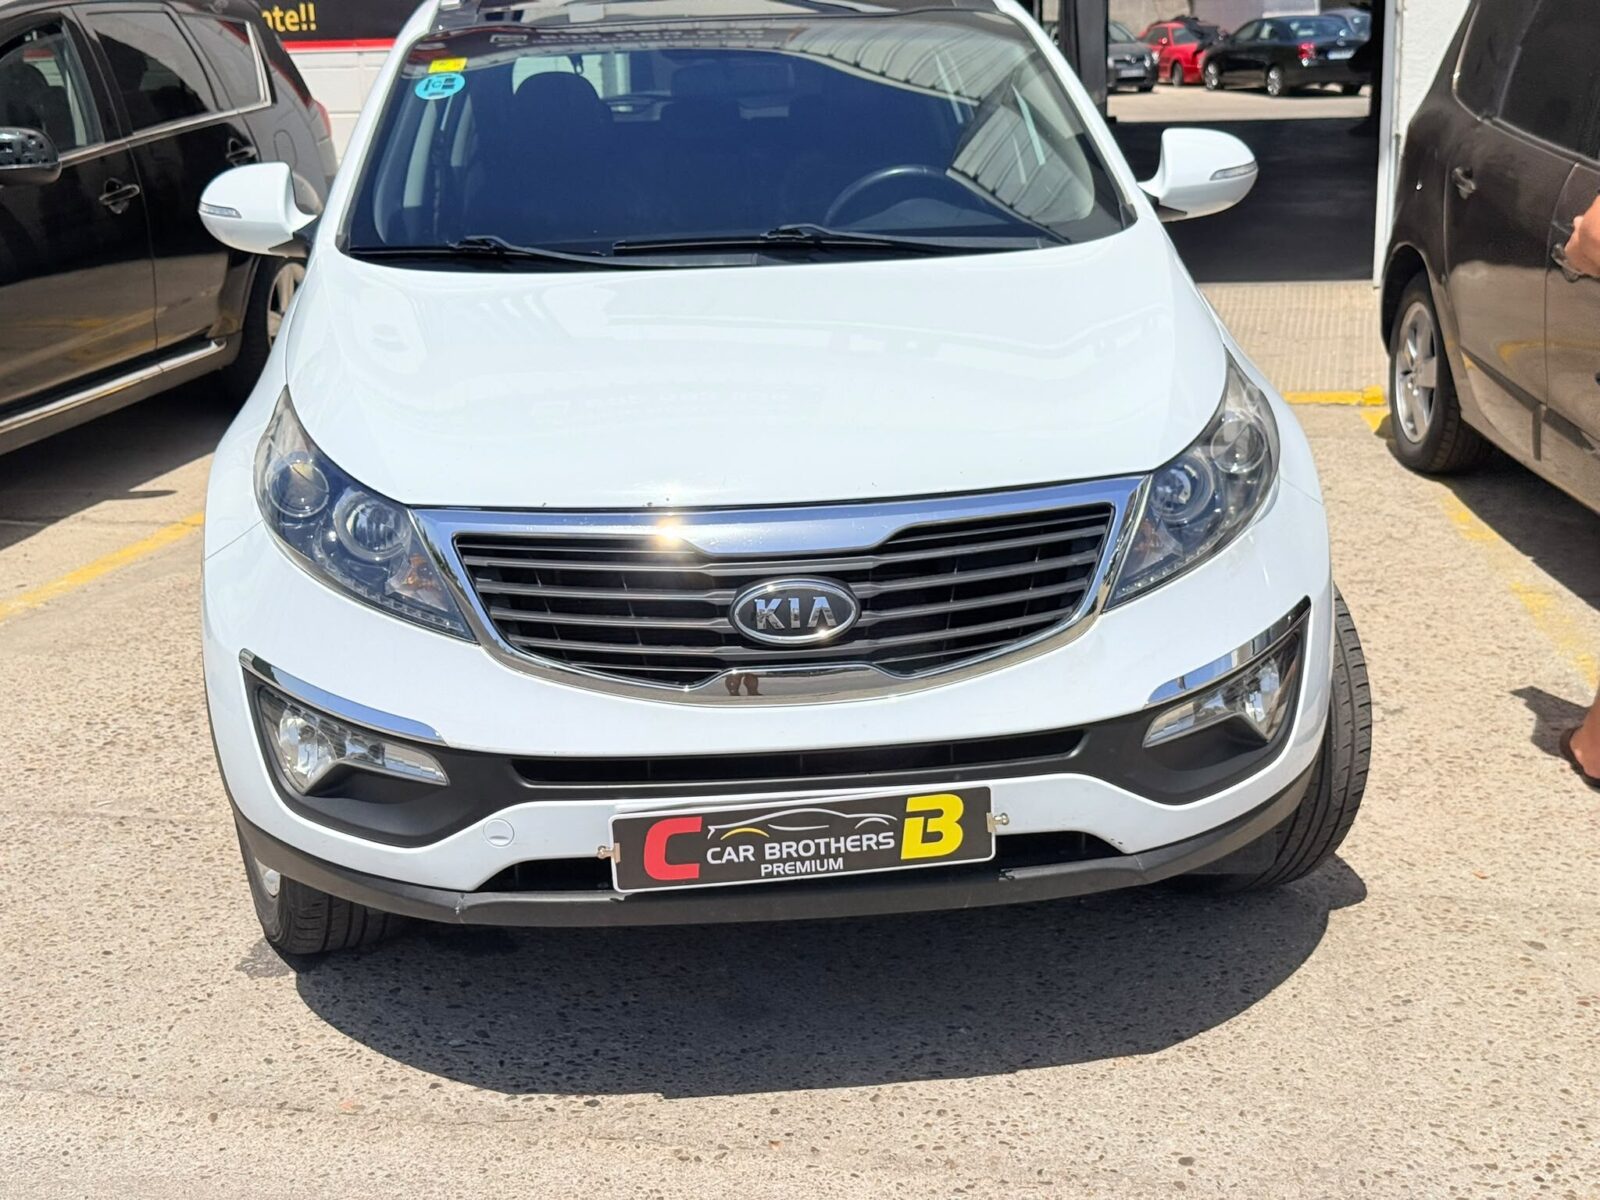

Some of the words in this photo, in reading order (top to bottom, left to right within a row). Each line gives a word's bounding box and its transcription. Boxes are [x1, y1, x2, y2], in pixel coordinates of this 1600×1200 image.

[754, 596, 838, 629] KIA
[900, 793, 965, 860] B
[643, 815, 703, 881] C
[706, 844, 755, 865] CAR
[764, 831, 896, 860] BROTHERS
[760, 857, 844, 877] PREMIUM
